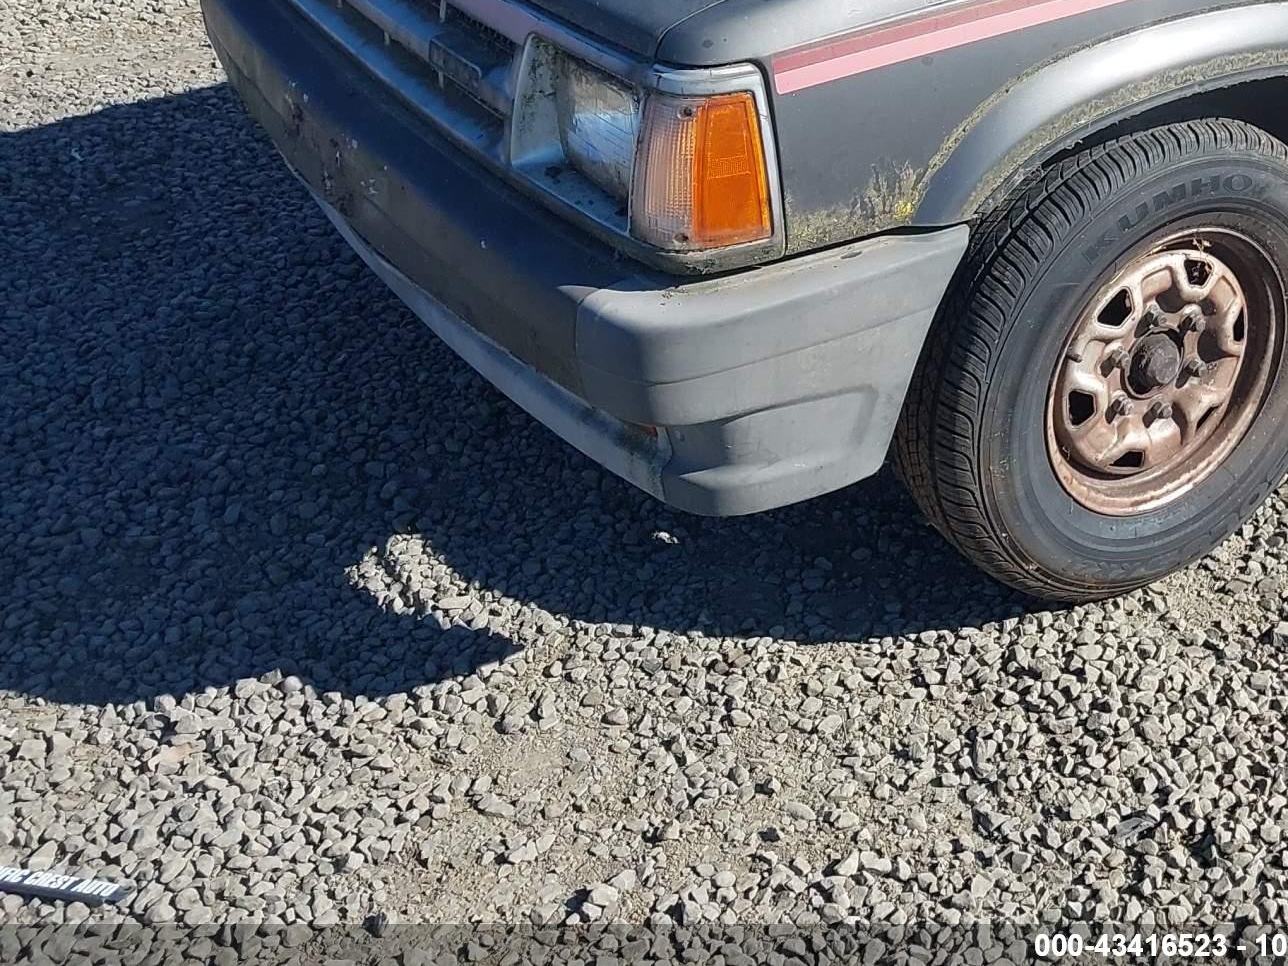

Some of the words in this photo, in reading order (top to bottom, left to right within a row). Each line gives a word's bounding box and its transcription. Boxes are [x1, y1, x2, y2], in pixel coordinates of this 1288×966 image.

[1081, 173, 1253, 265] KUMHO
[24, 871, 80, 890] CREST
[71, 878, 120, 897] AUTO
